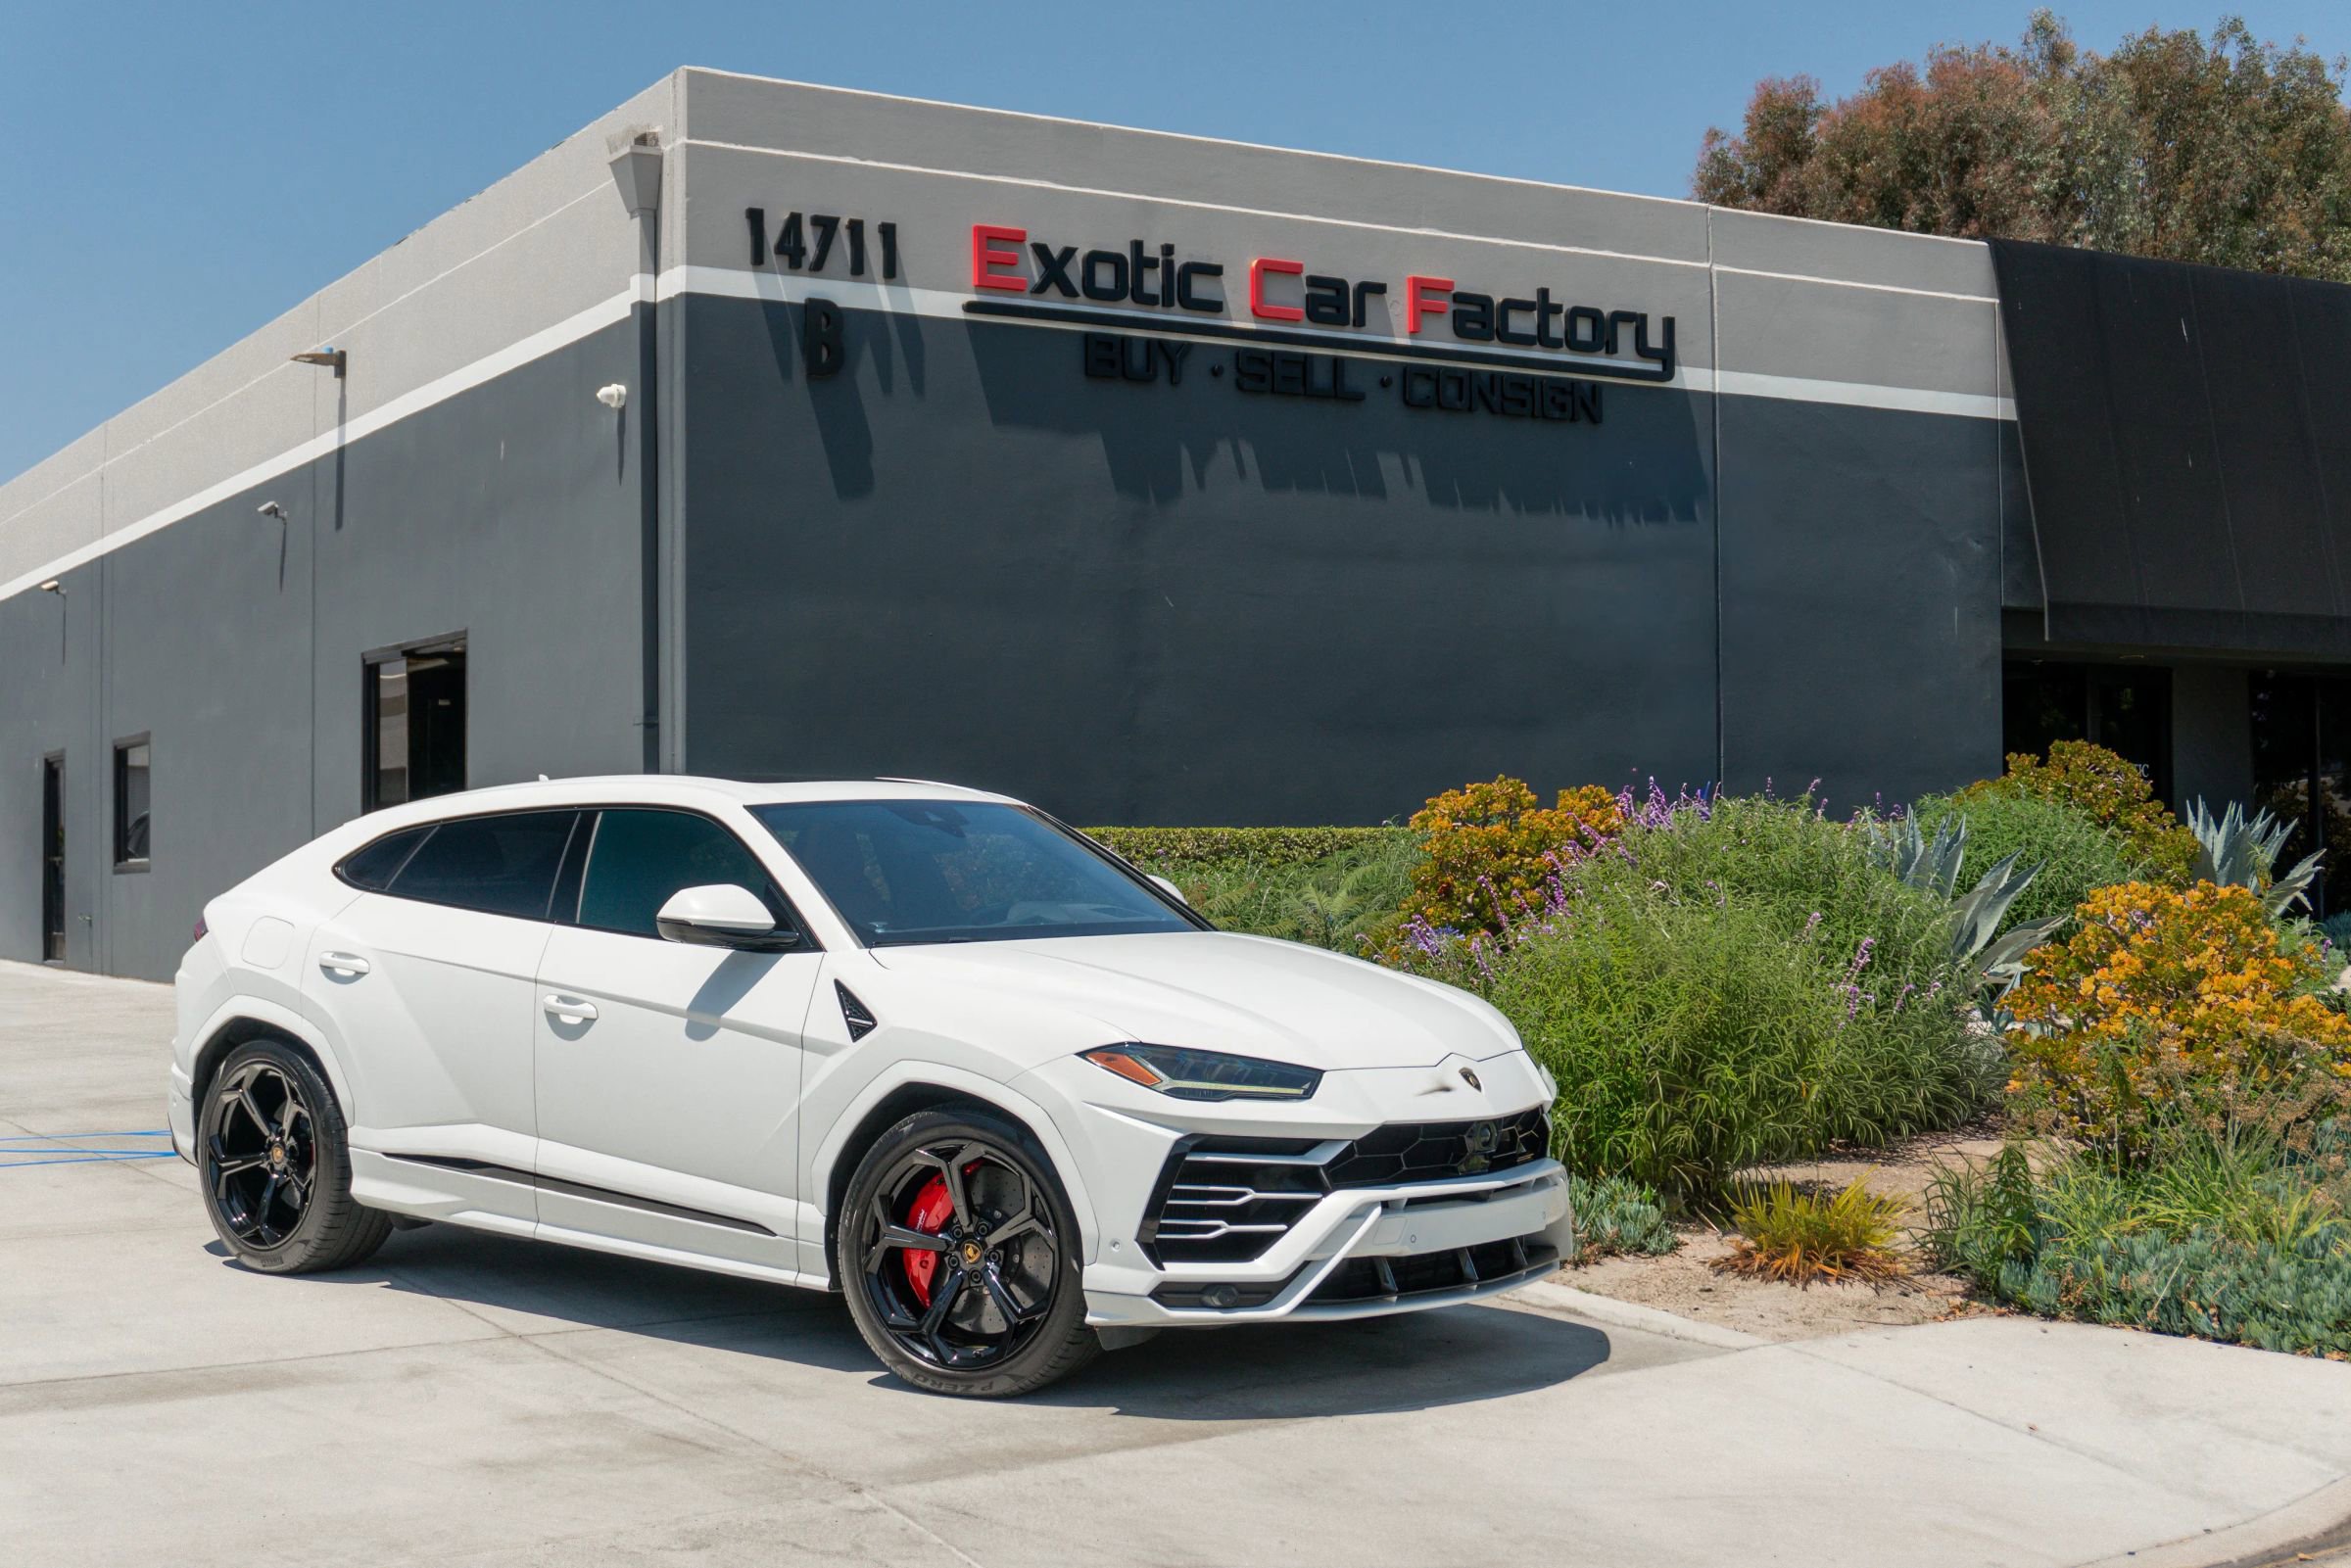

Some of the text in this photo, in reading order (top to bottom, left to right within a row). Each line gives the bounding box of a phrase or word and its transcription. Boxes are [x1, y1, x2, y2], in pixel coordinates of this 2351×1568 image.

[745, 208, 897, 279] 14711
[804, 298, 845, 379] B
[973, 224, 1676, 382] Exotic Car Factory
[1084, 334, 1604, 424] BUY SELL CONSIGN
